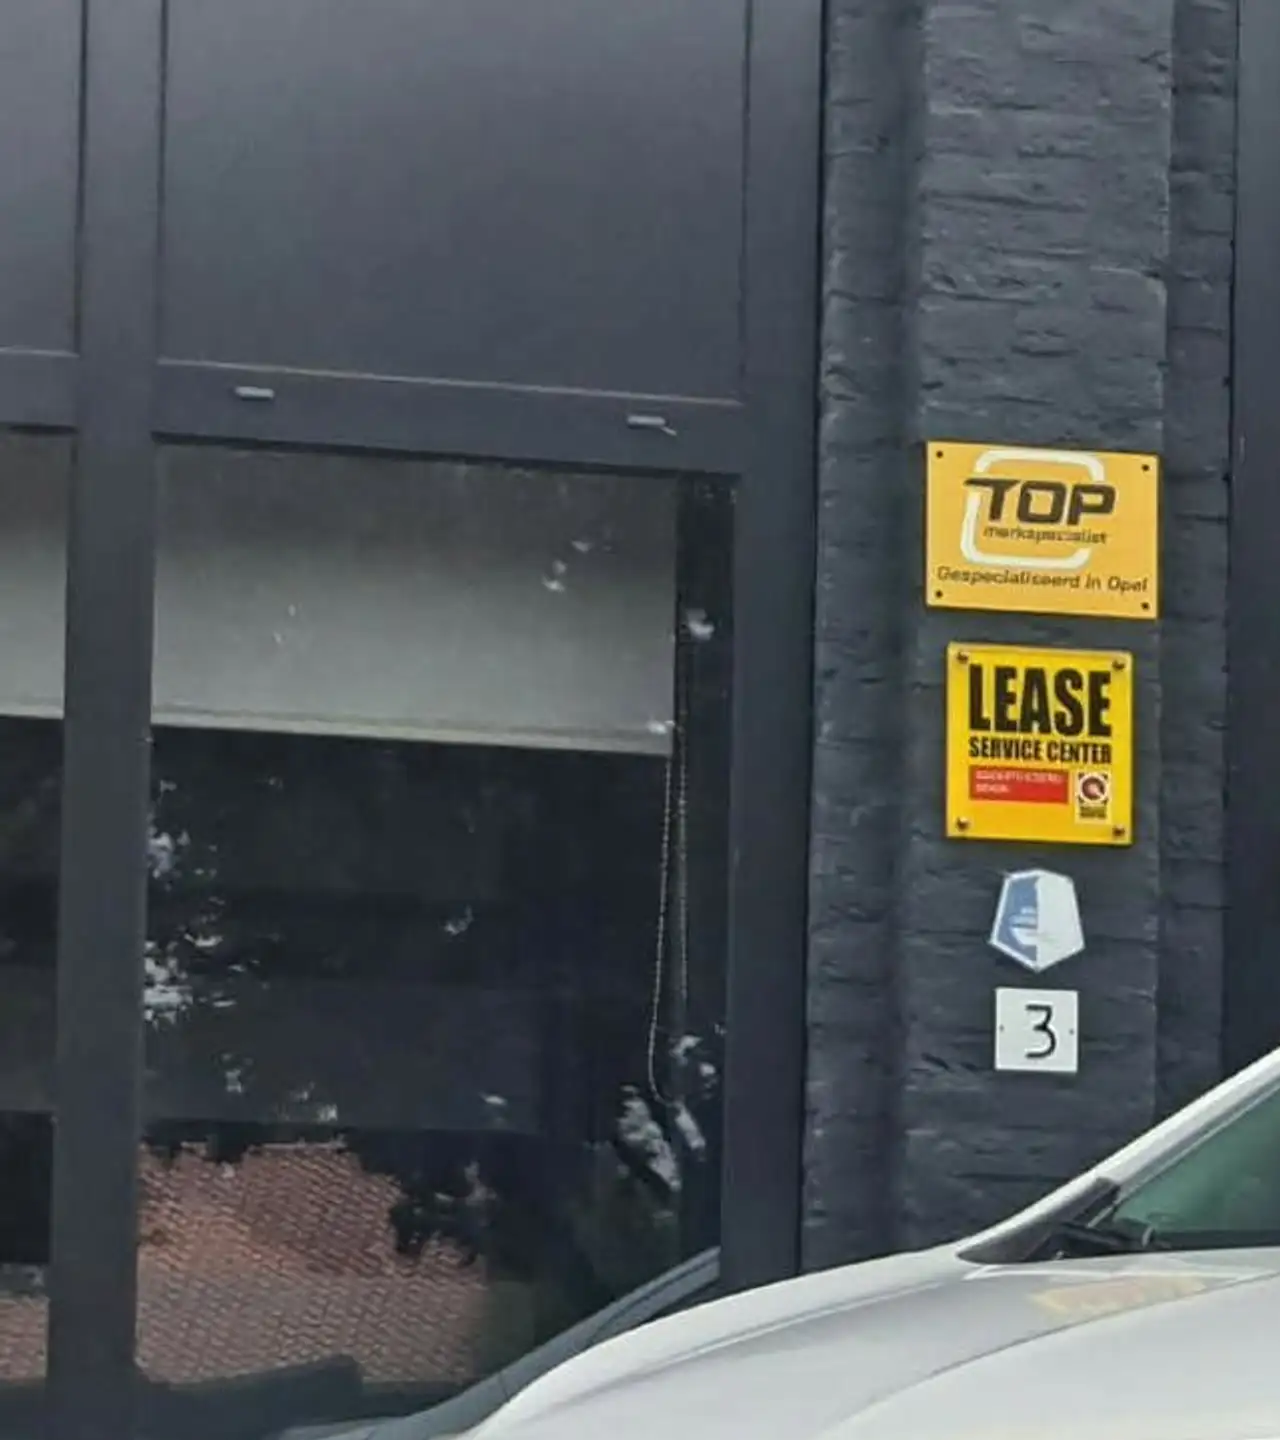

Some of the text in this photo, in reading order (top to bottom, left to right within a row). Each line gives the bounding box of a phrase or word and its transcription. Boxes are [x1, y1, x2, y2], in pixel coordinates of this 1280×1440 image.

[963, 478, 1117, 526] TOP
[937, 566, 1149, 594] Gespecialiseerd in Opel
[968, 664, 1112, 737] LEASE
[968, 737, 1112, 765] SERVICE CENTER
[1024, 1004, 1057, 1060] 3
